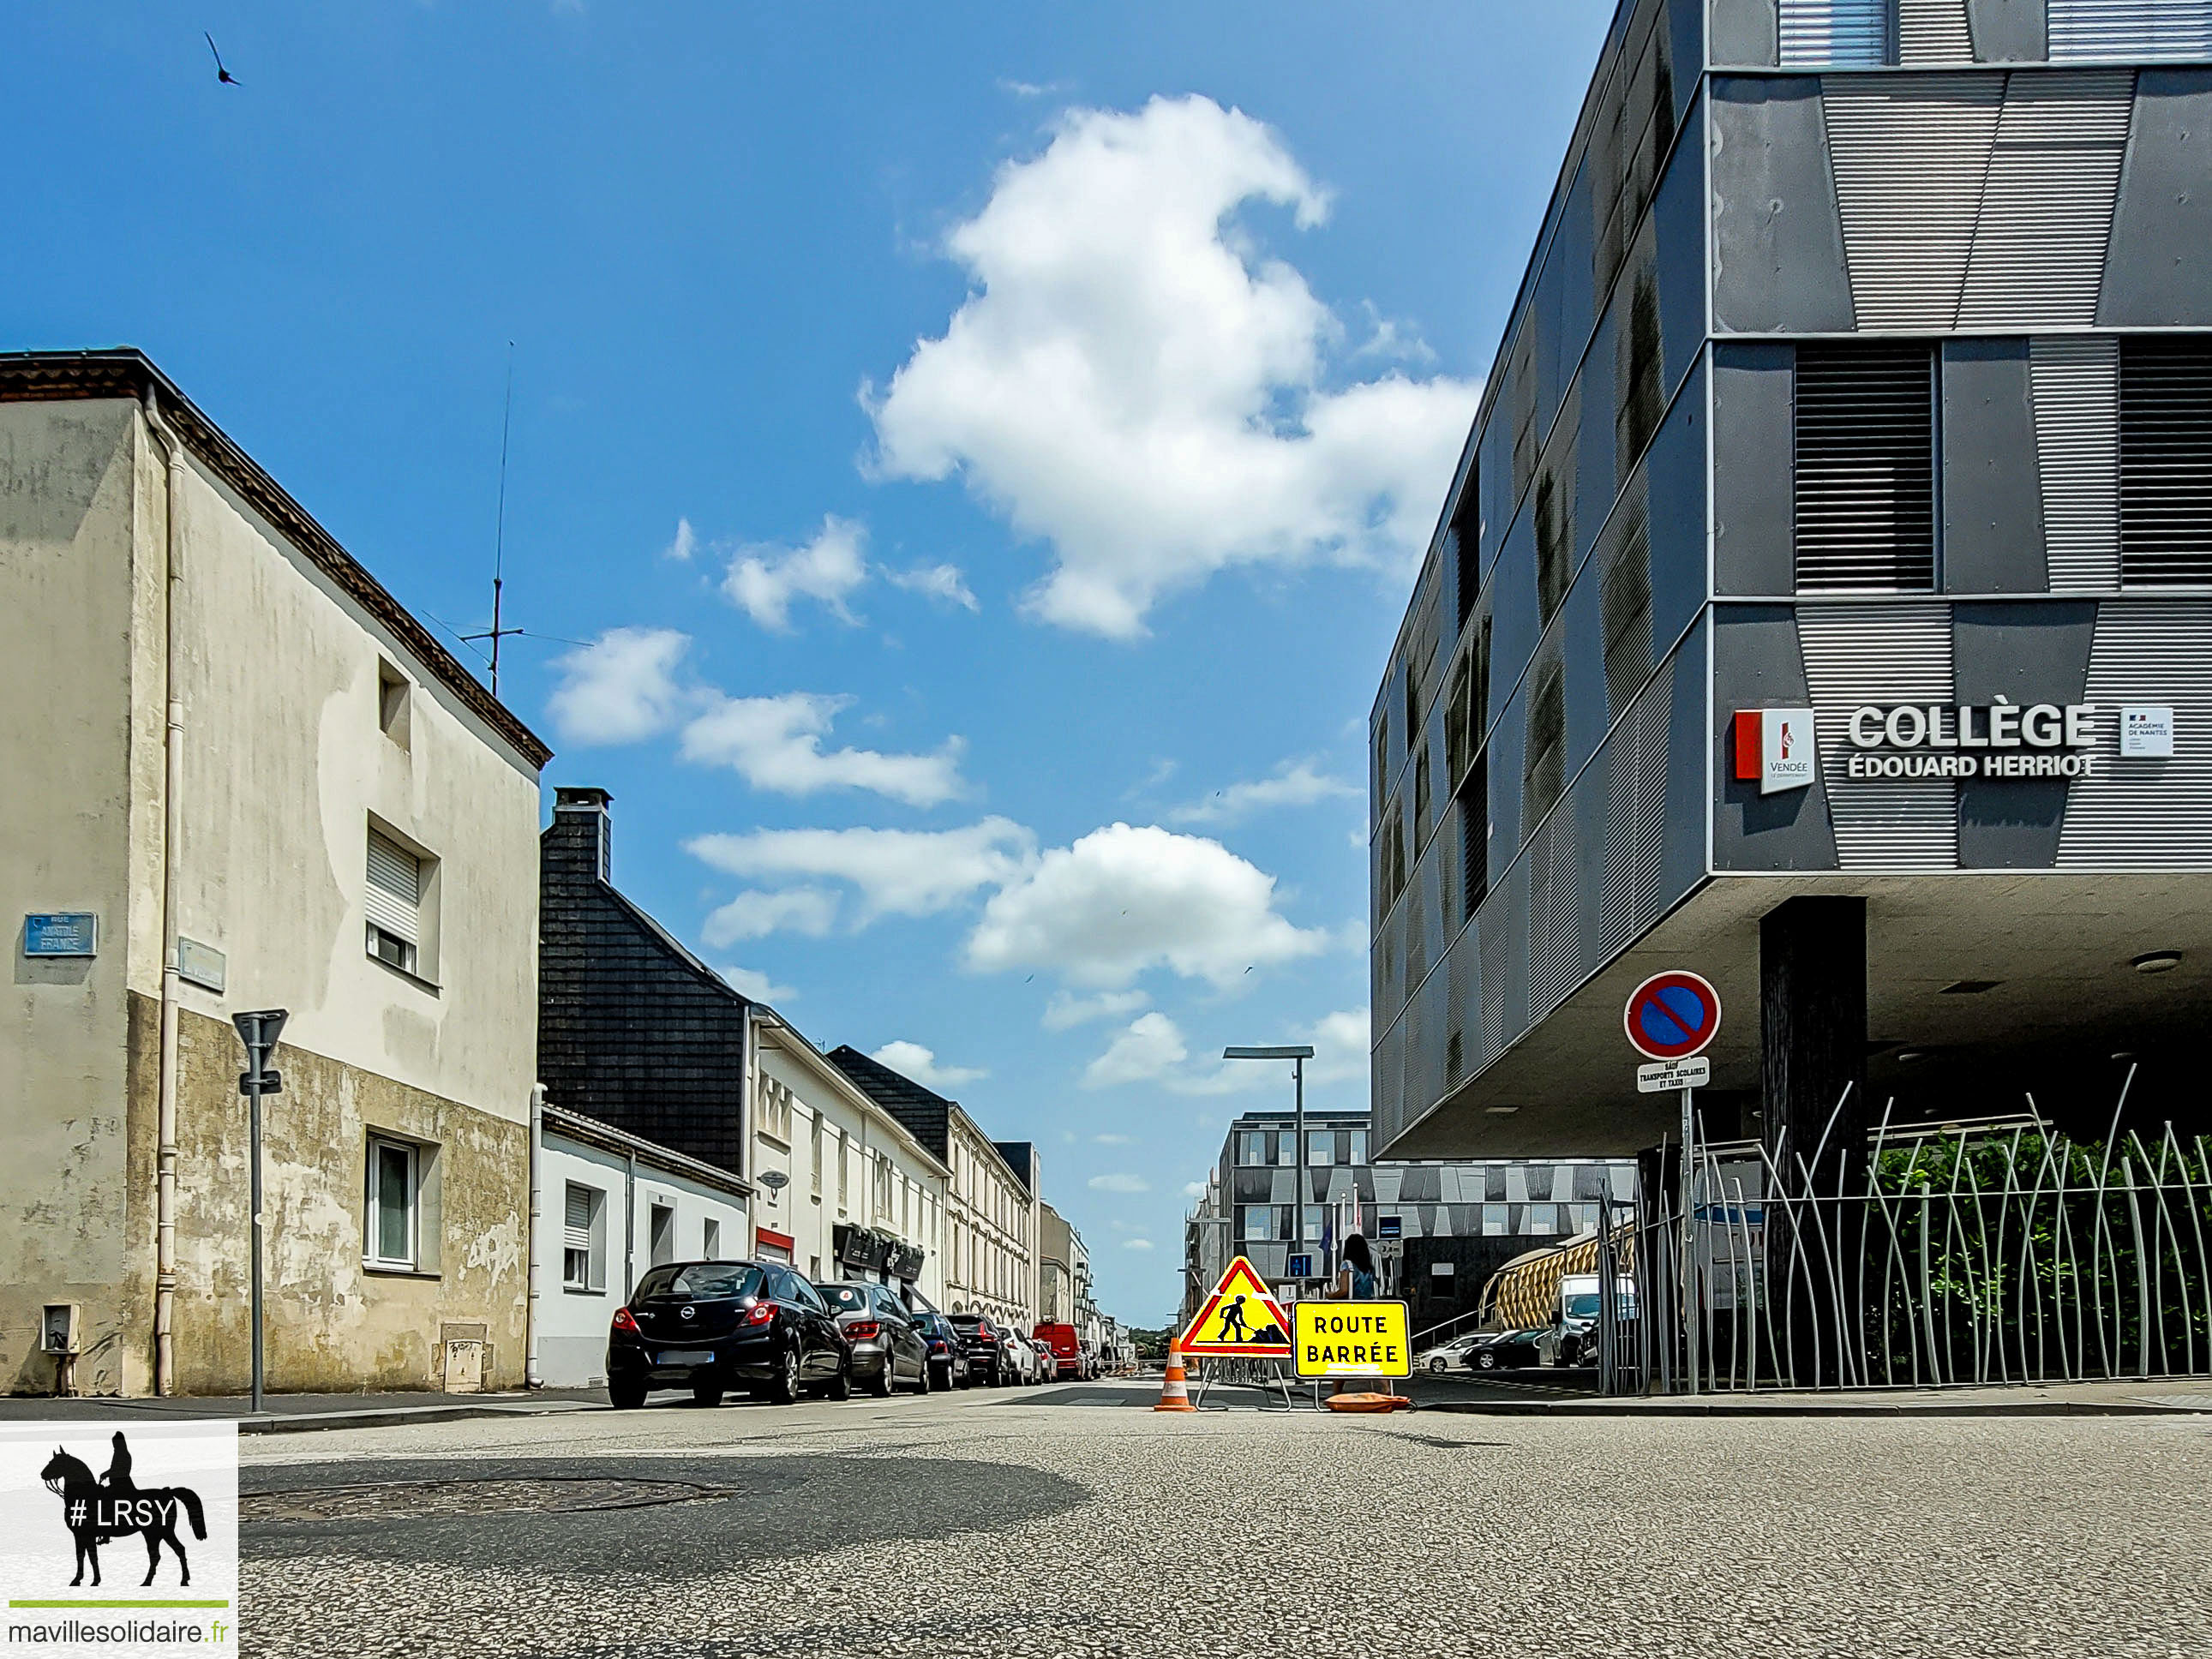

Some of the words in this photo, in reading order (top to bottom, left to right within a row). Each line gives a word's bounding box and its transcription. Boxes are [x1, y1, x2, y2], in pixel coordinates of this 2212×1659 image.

[1849, 694, 2096, 748] COLLÈGE
[1770, 762, 1807, 772] VENDÉE
[1848, 753, 1977, 778] ÉDOUARD
[1983, 755, 2094, 776] HERRIOT
[1640, 1070, 1674, 1082] TRANSPORTS
[1659, 1080, 1666, 1088] ET
[1315, 1316, 1388, 1333] ROUTE
[1307, 1341, 1399, 1363] BARRÉE
